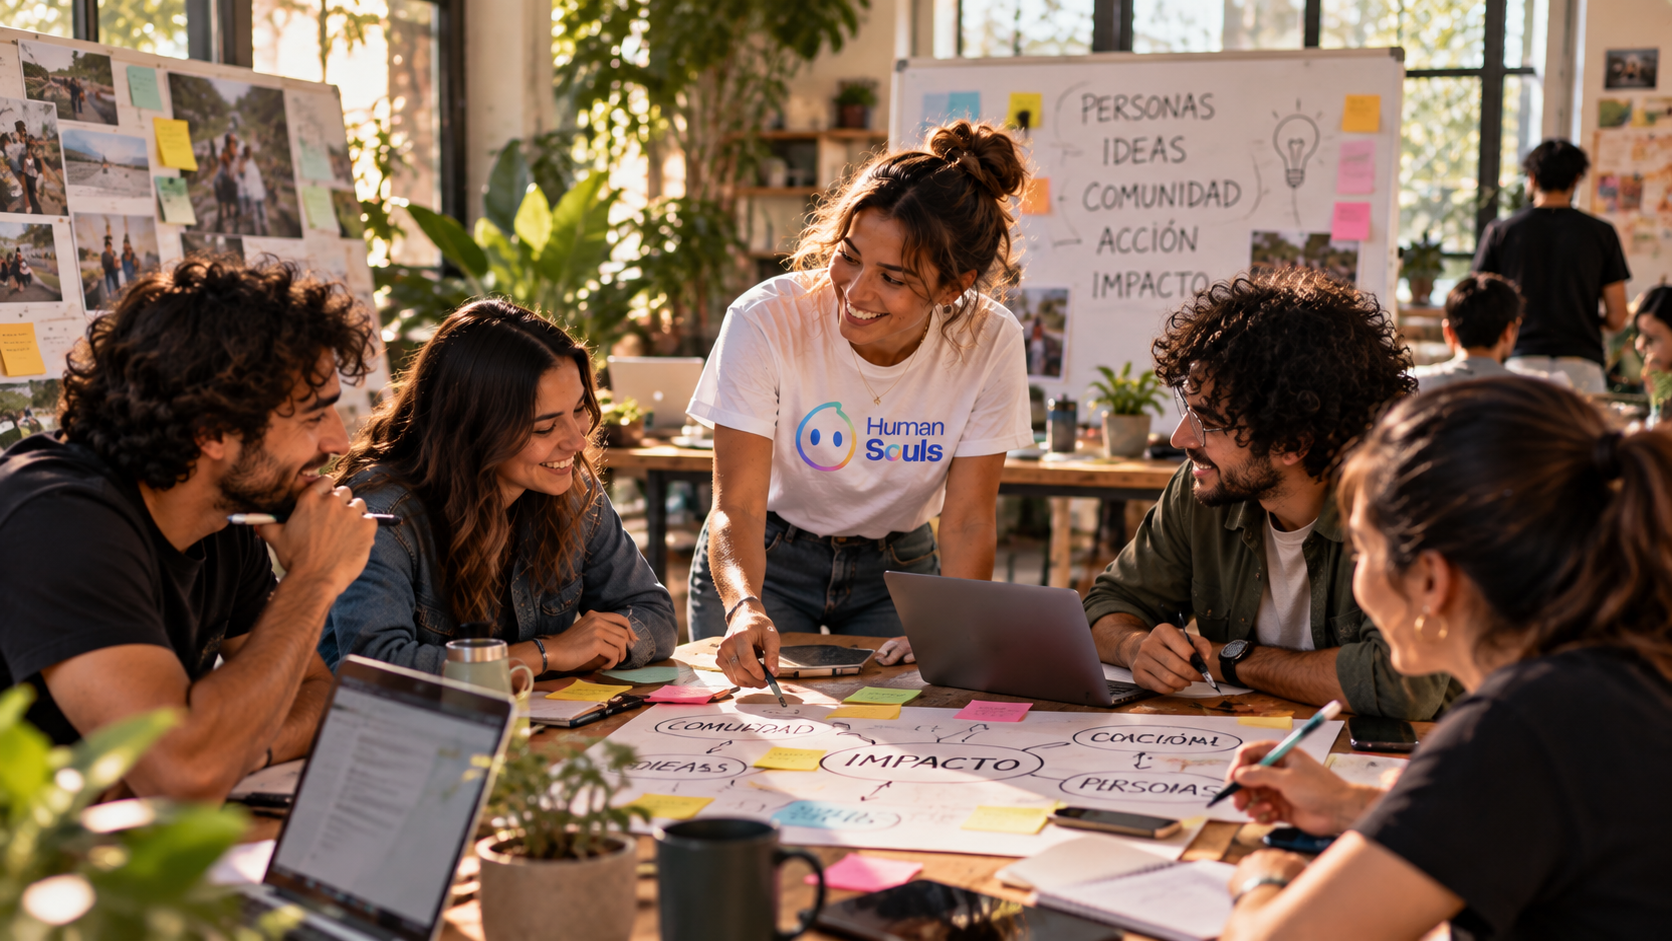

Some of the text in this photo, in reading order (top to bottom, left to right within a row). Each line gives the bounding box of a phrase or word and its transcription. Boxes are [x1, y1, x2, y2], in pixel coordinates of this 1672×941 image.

[1081, 92, 1215, 125] PERSONAS
[1102, 135, 1187, 166] IDEAS
[1082, 179, 1242, 212] COMUNIDAD
[1096, 219, 1199, 255] ACCIÓN
[1092, 270, 1210, 299] IMPACTO
[866, 416, 945, 436] Human
[865, 438, 943, 462] Souls
[844, 753, 1021, 772] IMPACTO
